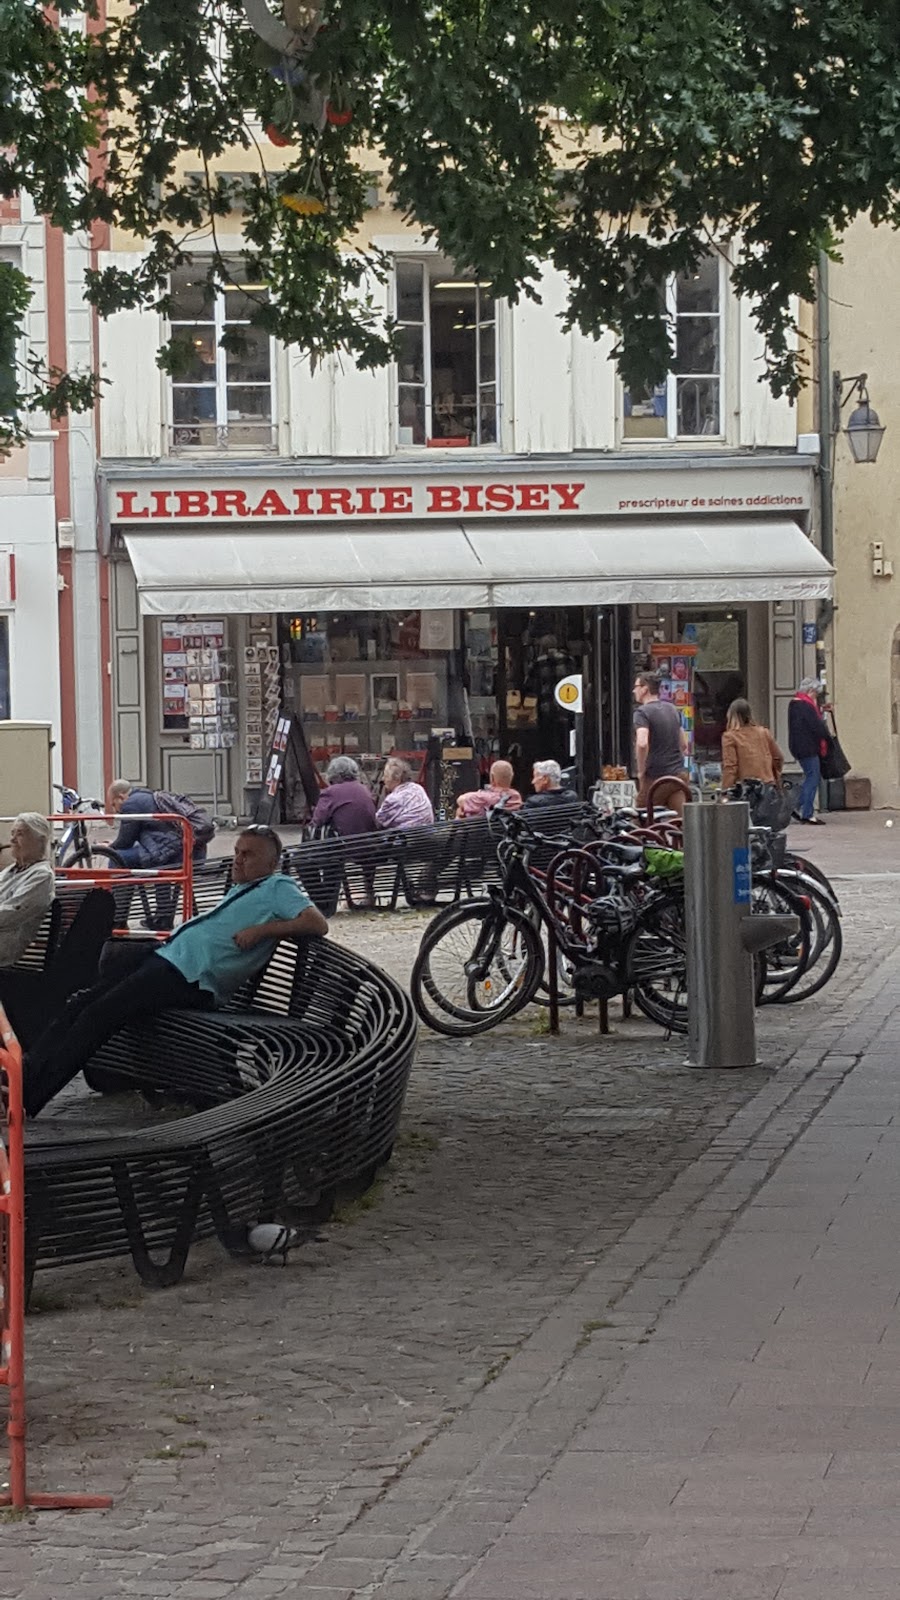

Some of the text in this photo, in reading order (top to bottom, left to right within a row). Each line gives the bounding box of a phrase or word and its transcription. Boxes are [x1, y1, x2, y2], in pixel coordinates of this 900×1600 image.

[116, 482, 585, 518] LIBRAIRIE BISEY
[618, 494, 804, 510] prescripteur de saines addictions
